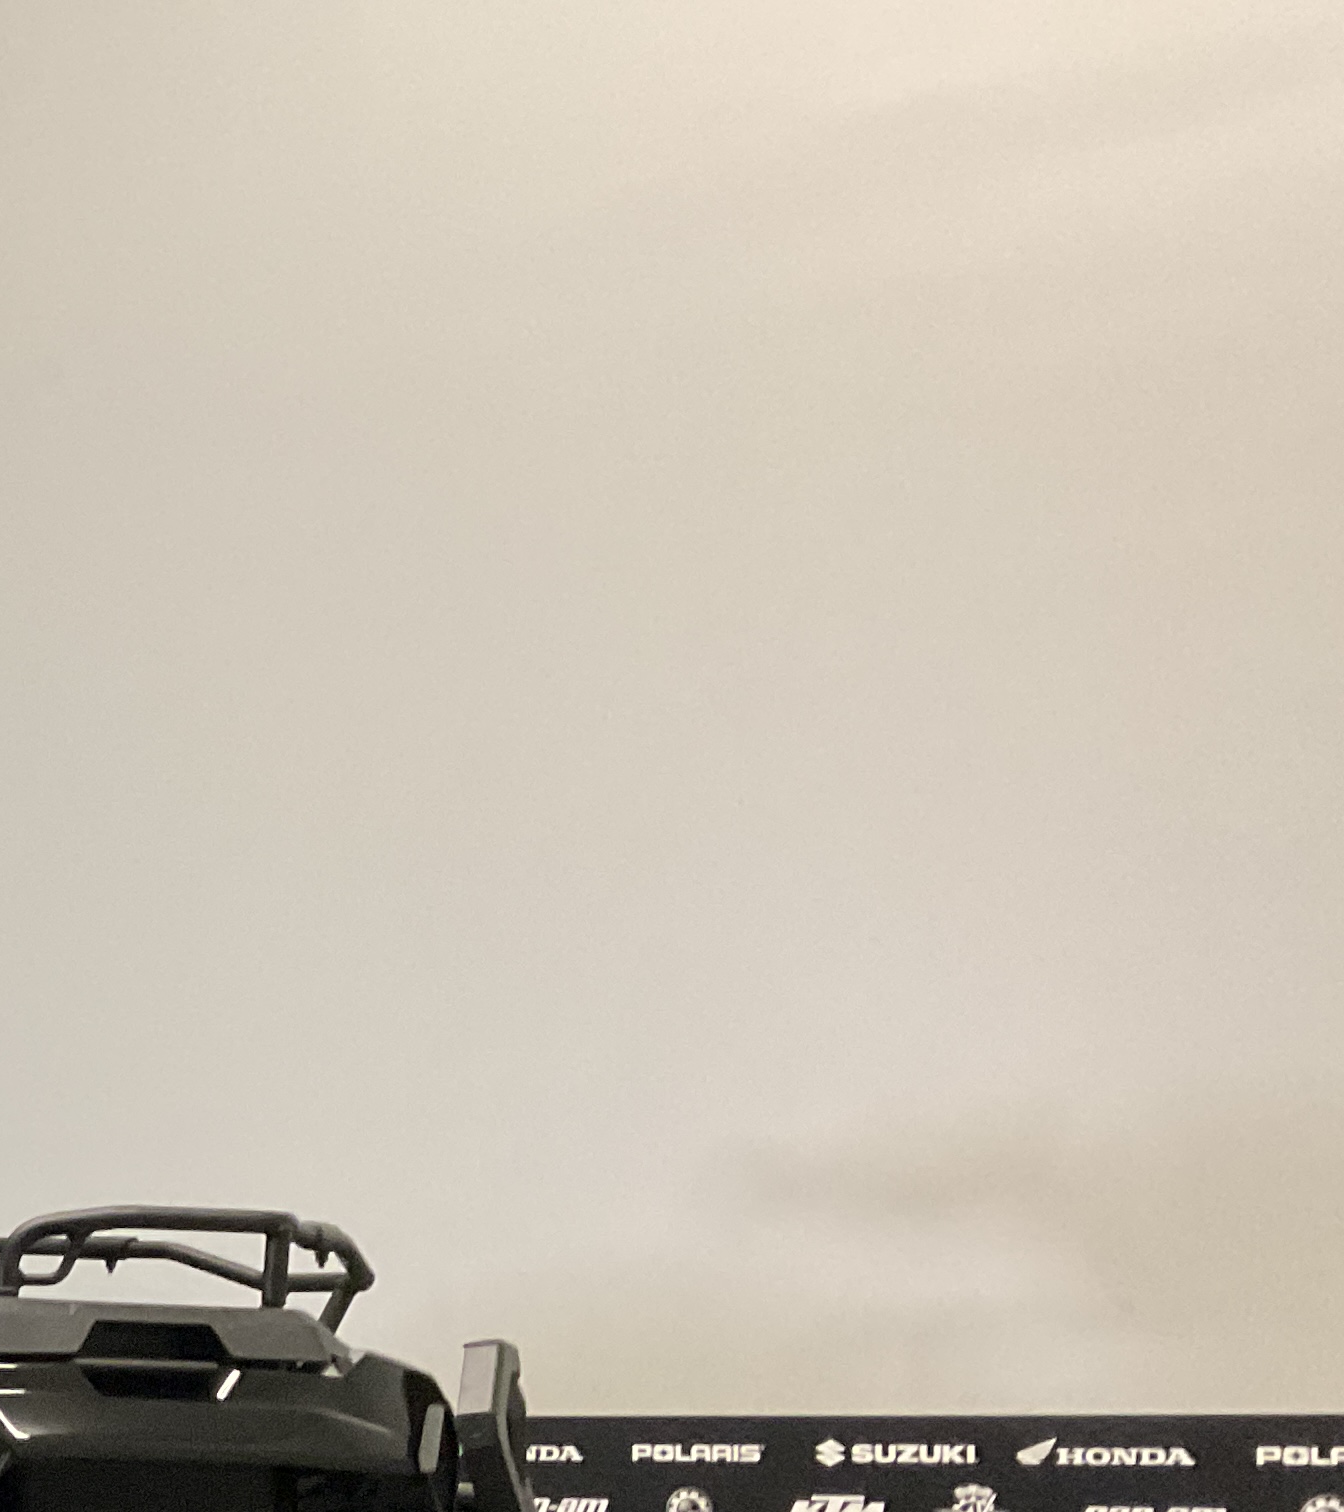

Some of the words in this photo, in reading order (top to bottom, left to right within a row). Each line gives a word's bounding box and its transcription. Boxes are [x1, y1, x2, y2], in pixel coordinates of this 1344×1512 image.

[632, 1444, 764, 1462] POLARIS
[852, 1444, 975, 1464] SUZUKI
[1057, 1447, 1195, 1466] HONDA
